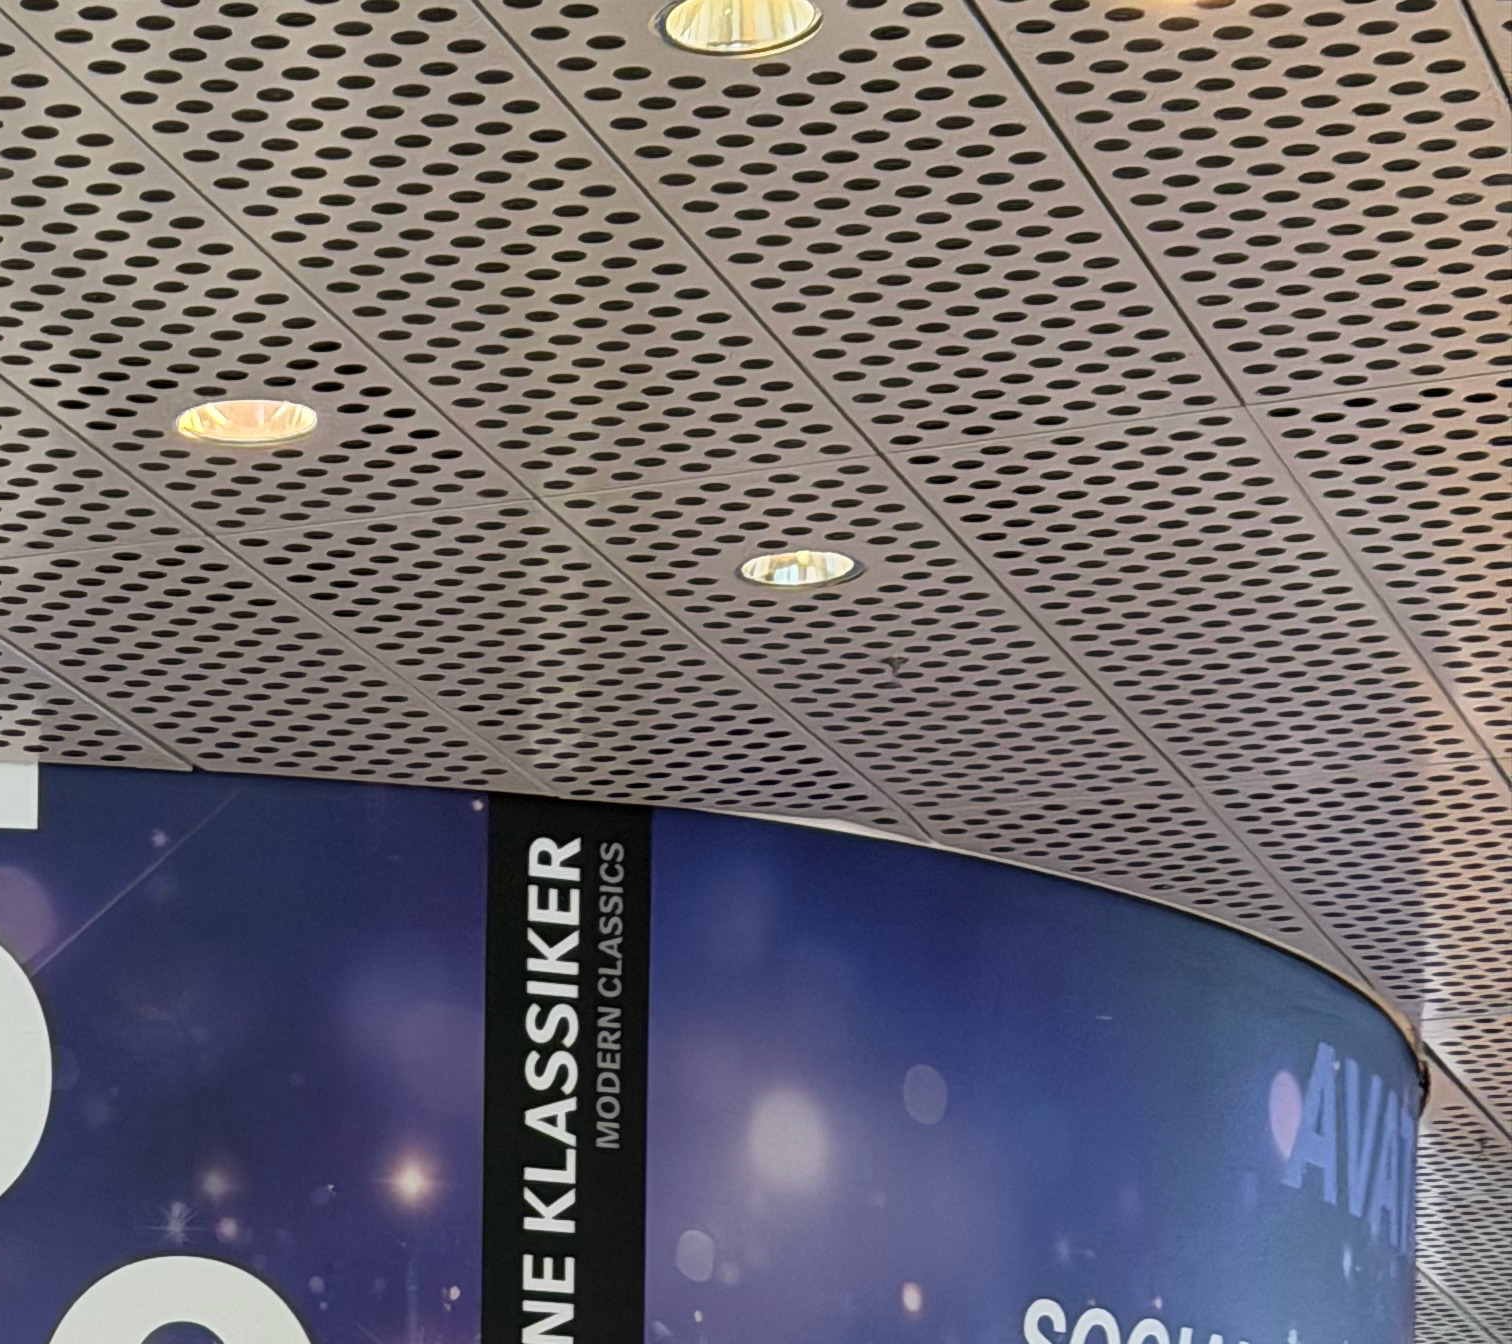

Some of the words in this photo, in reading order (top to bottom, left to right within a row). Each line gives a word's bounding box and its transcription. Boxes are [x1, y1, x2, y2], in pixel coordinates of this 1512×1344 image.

[599, 841, 626, 999] CLASSICS
[523, 836, 582, 1233] KLASSIKER
[595, 1006, 622, 1150] MODERN
